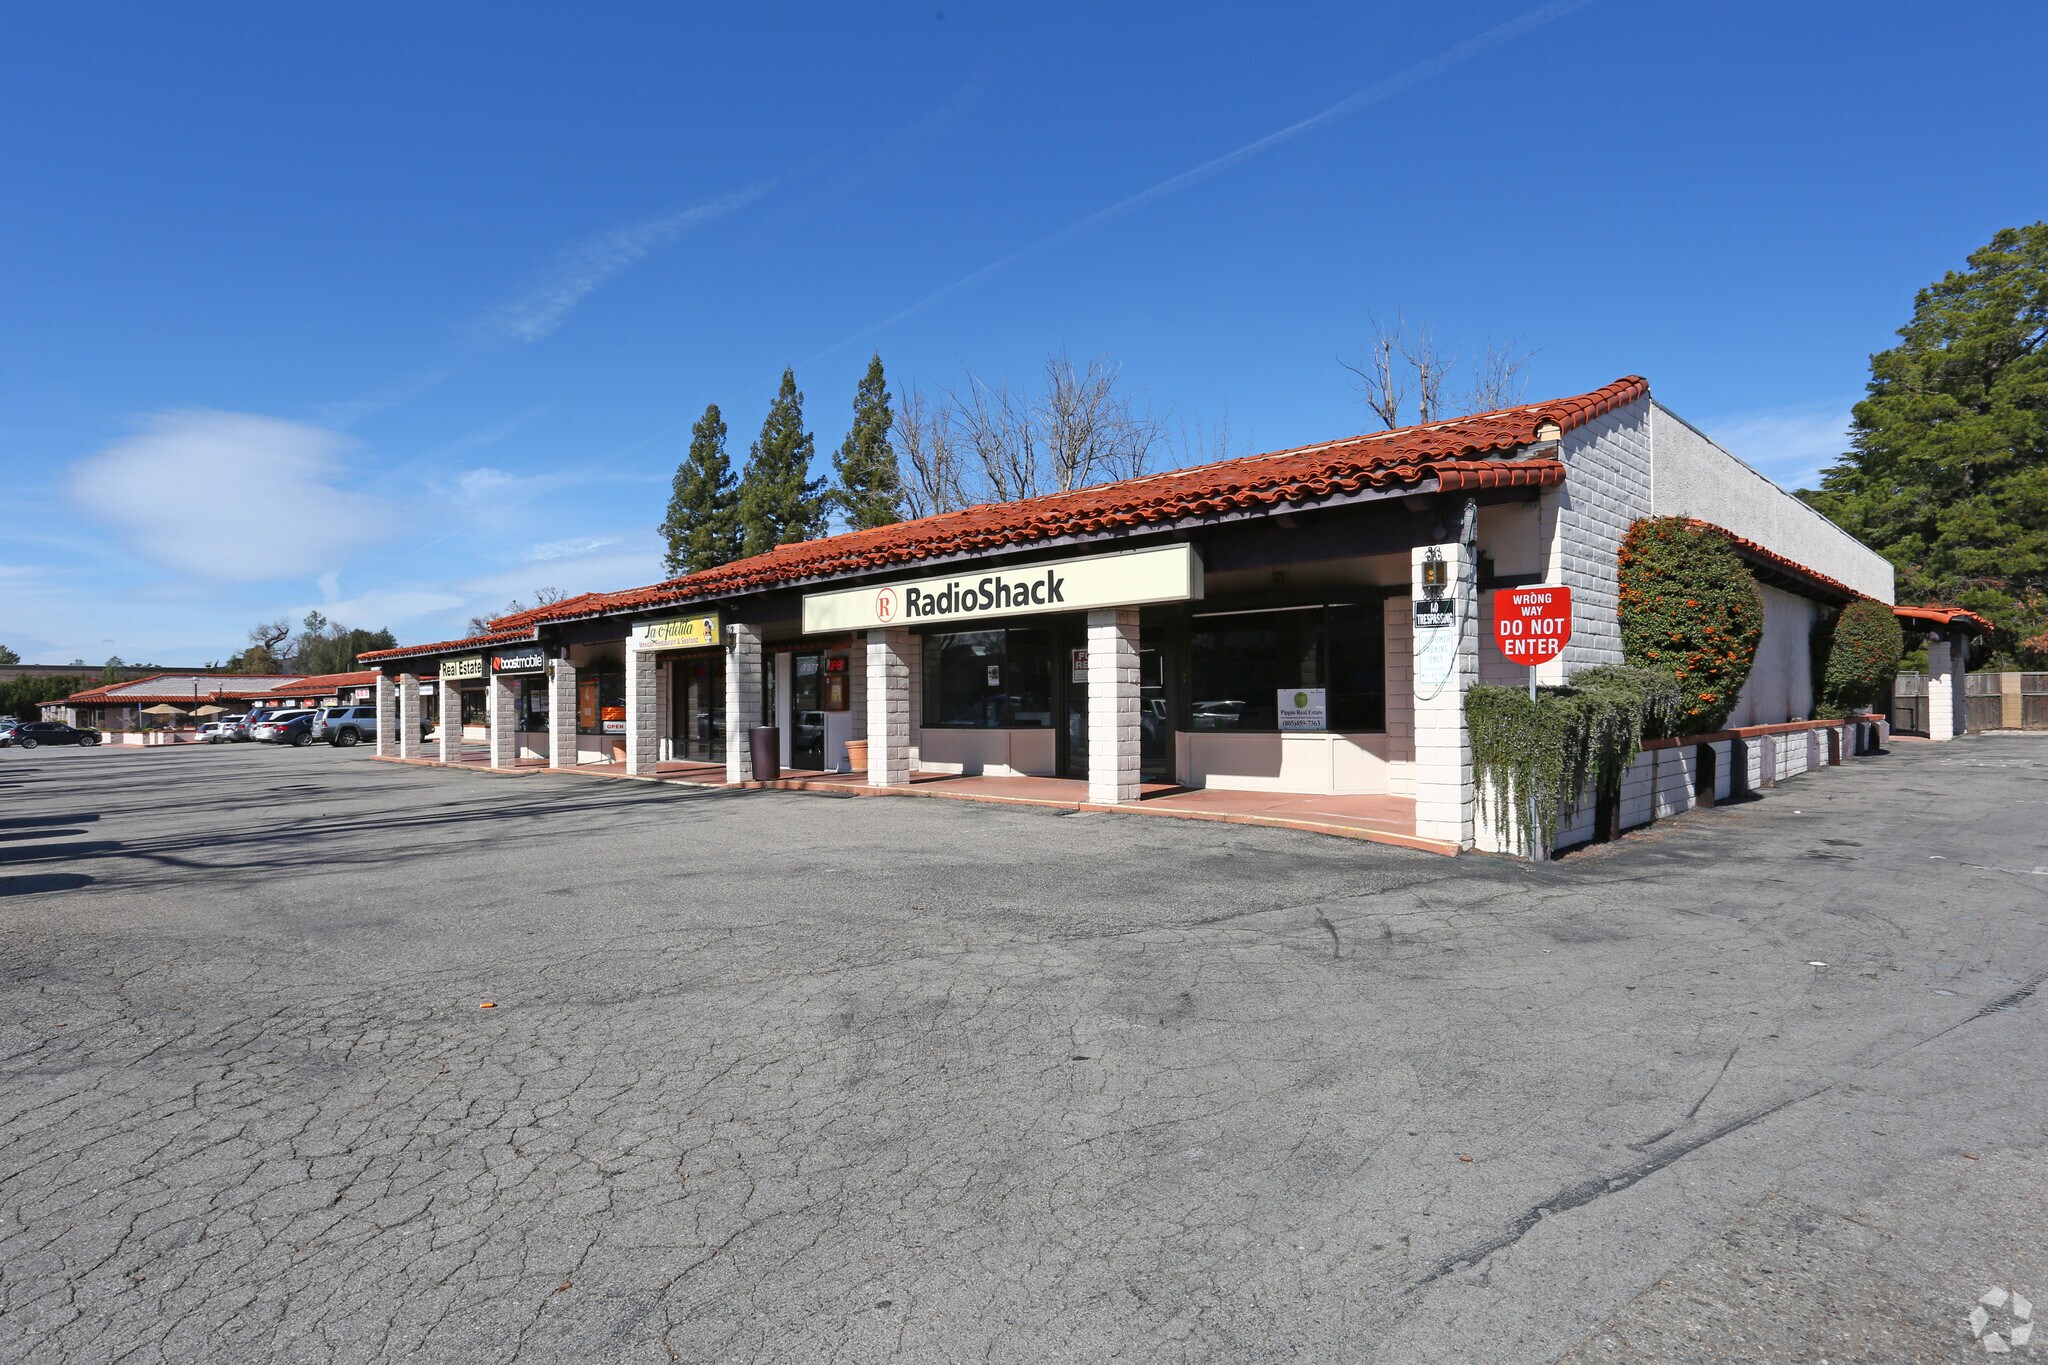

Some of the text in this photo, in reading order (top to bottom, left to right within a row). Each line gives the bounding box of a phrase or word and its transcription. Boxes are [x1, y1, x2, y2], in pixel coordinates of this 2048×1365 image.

[906, 570, 1065, 618] RadioShack
[1513, 592, 1552, 605] WRONG
[1430, 602, 1439, 613] NO
[1521, 606, 1543, 617] WAY
[644, 619, 694, 642] La Adelita
[1500, 618, 1565, 636] DO NOT
[1505, 638, 1559, 655] ENTER
[1428, 655, 1444, 664] ONLY
[442, 660, 482, 677] Real Estate
